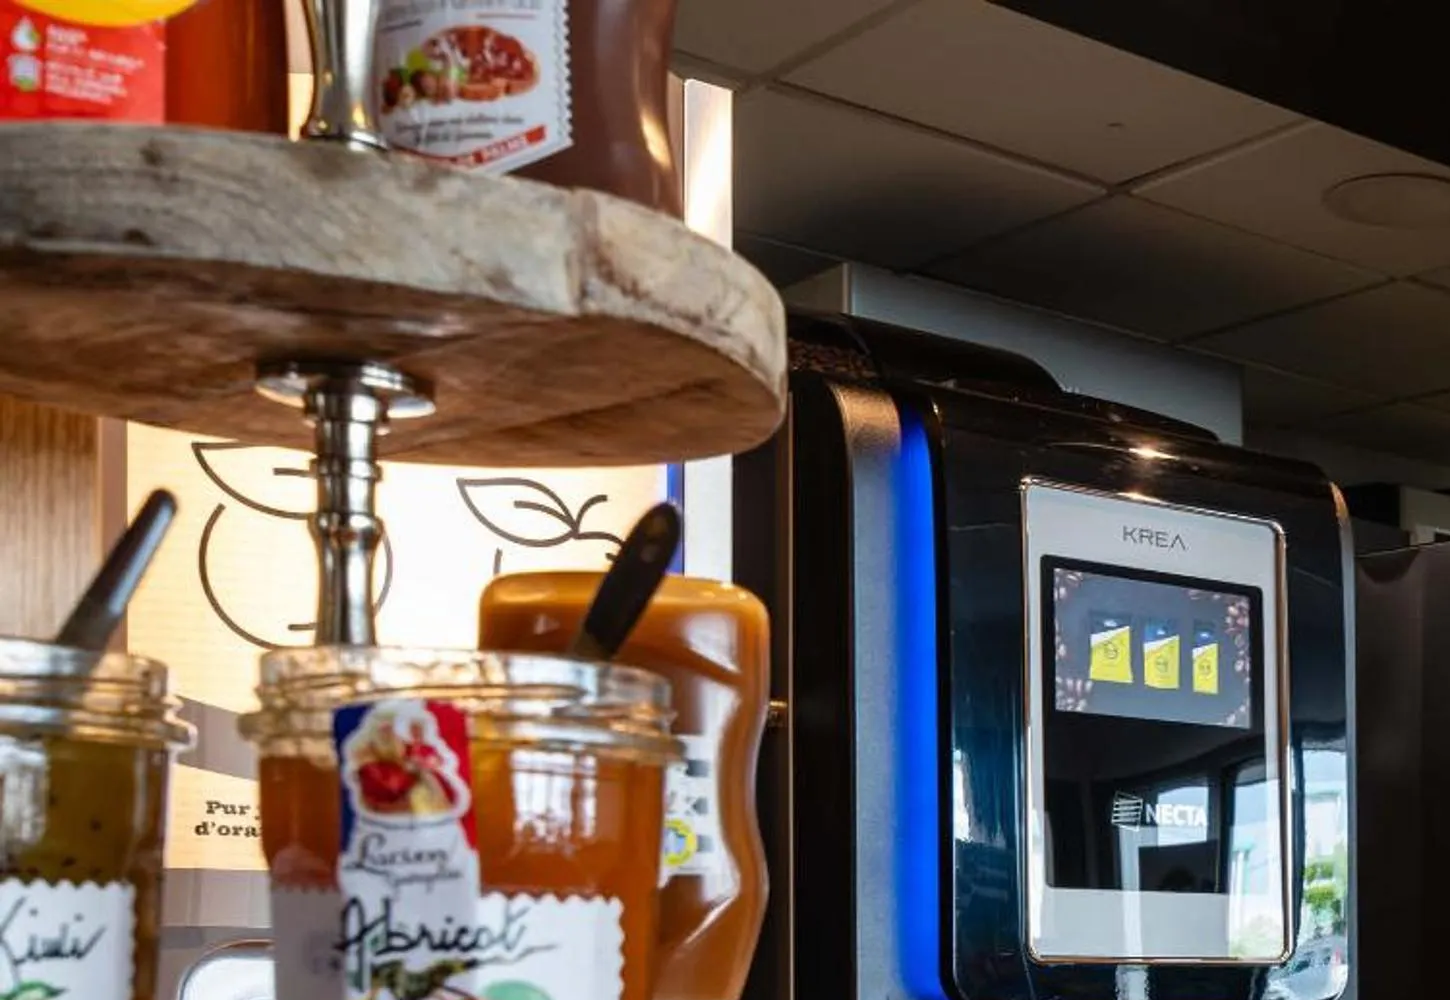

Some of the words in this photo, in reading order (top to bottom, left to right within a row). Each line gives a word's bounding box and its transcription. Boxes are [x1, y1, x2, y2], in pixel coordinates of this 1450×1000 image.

[1122, 525, 1187, 552] KREA
[206, 800, 252, 815] Pur
[1145, 803, 1208, 827] NECTA
[194, 821, 261, 838] d'ora
[333, 897, 533, 968] Abricot
